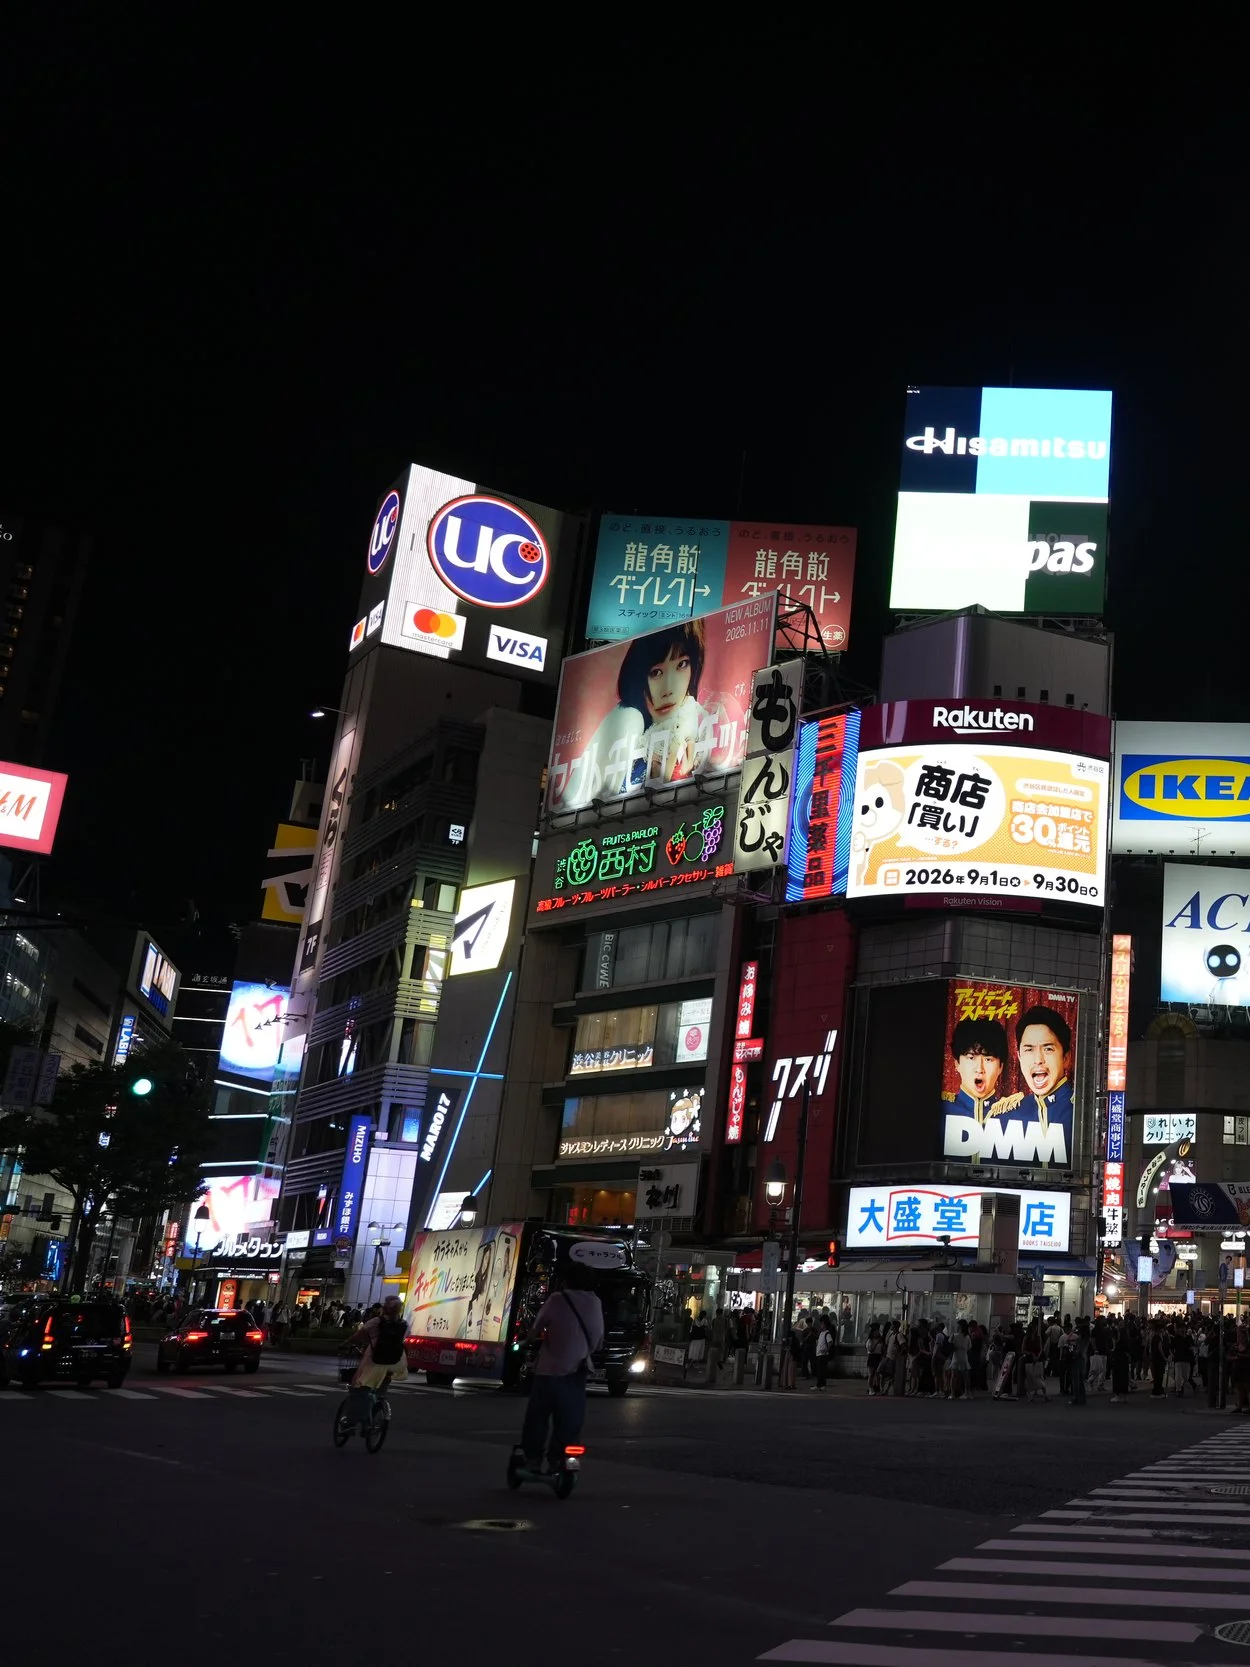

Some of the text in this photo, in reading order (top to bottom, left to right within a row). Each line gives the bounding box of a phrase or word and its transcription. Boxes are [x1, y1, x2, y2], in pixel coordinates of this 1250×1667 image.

[906, 427, 1106, 459] Hisamitsu
[624, 541, 701, 575] 龍角散
[754, 548, 830, 581] 龍角散
[618, 608, 658, 619] スティック
[726, 599, 771, 624] NEW ALBUM
[412, 631, 453, 647] mastercard
[725, 620, 770, 642] 2026.11.11
[492, 633, 543, 662] VISA
[933, 706, 1034, 732] Rakuten
[740, 669, 796, 863] もんじゃ
[915, 764, 992, 810] 商店
[803, 722, 838, 888] 三千里薬品
[554, 858, 567, 890] 渋谷
[598, 840, 656, 881] 西村
[943, 896, 1003, 907] Rakuten Vision
[305, 935, 318, 956] 7F
[1048, 993, 1076, 1003] DMM TV
[1108, 1046, 1126, 1087] 三千
[764, 1029, 837, 1141] クスリ
[943, 1114, 1068, 1164] DMM
[1109, 1094, 1123, 1160] 大盛堂商事ビル
[1146, 1132, 1195, 1142] クリニック
[1158, 1117, 1195, 1129] れいわ
[352, 1125, 367, 1164] MIZUHO
[340, 1191, 354, 1233] みずほ銀行
[1106, 1208, 1119, 1236] 牛繁
